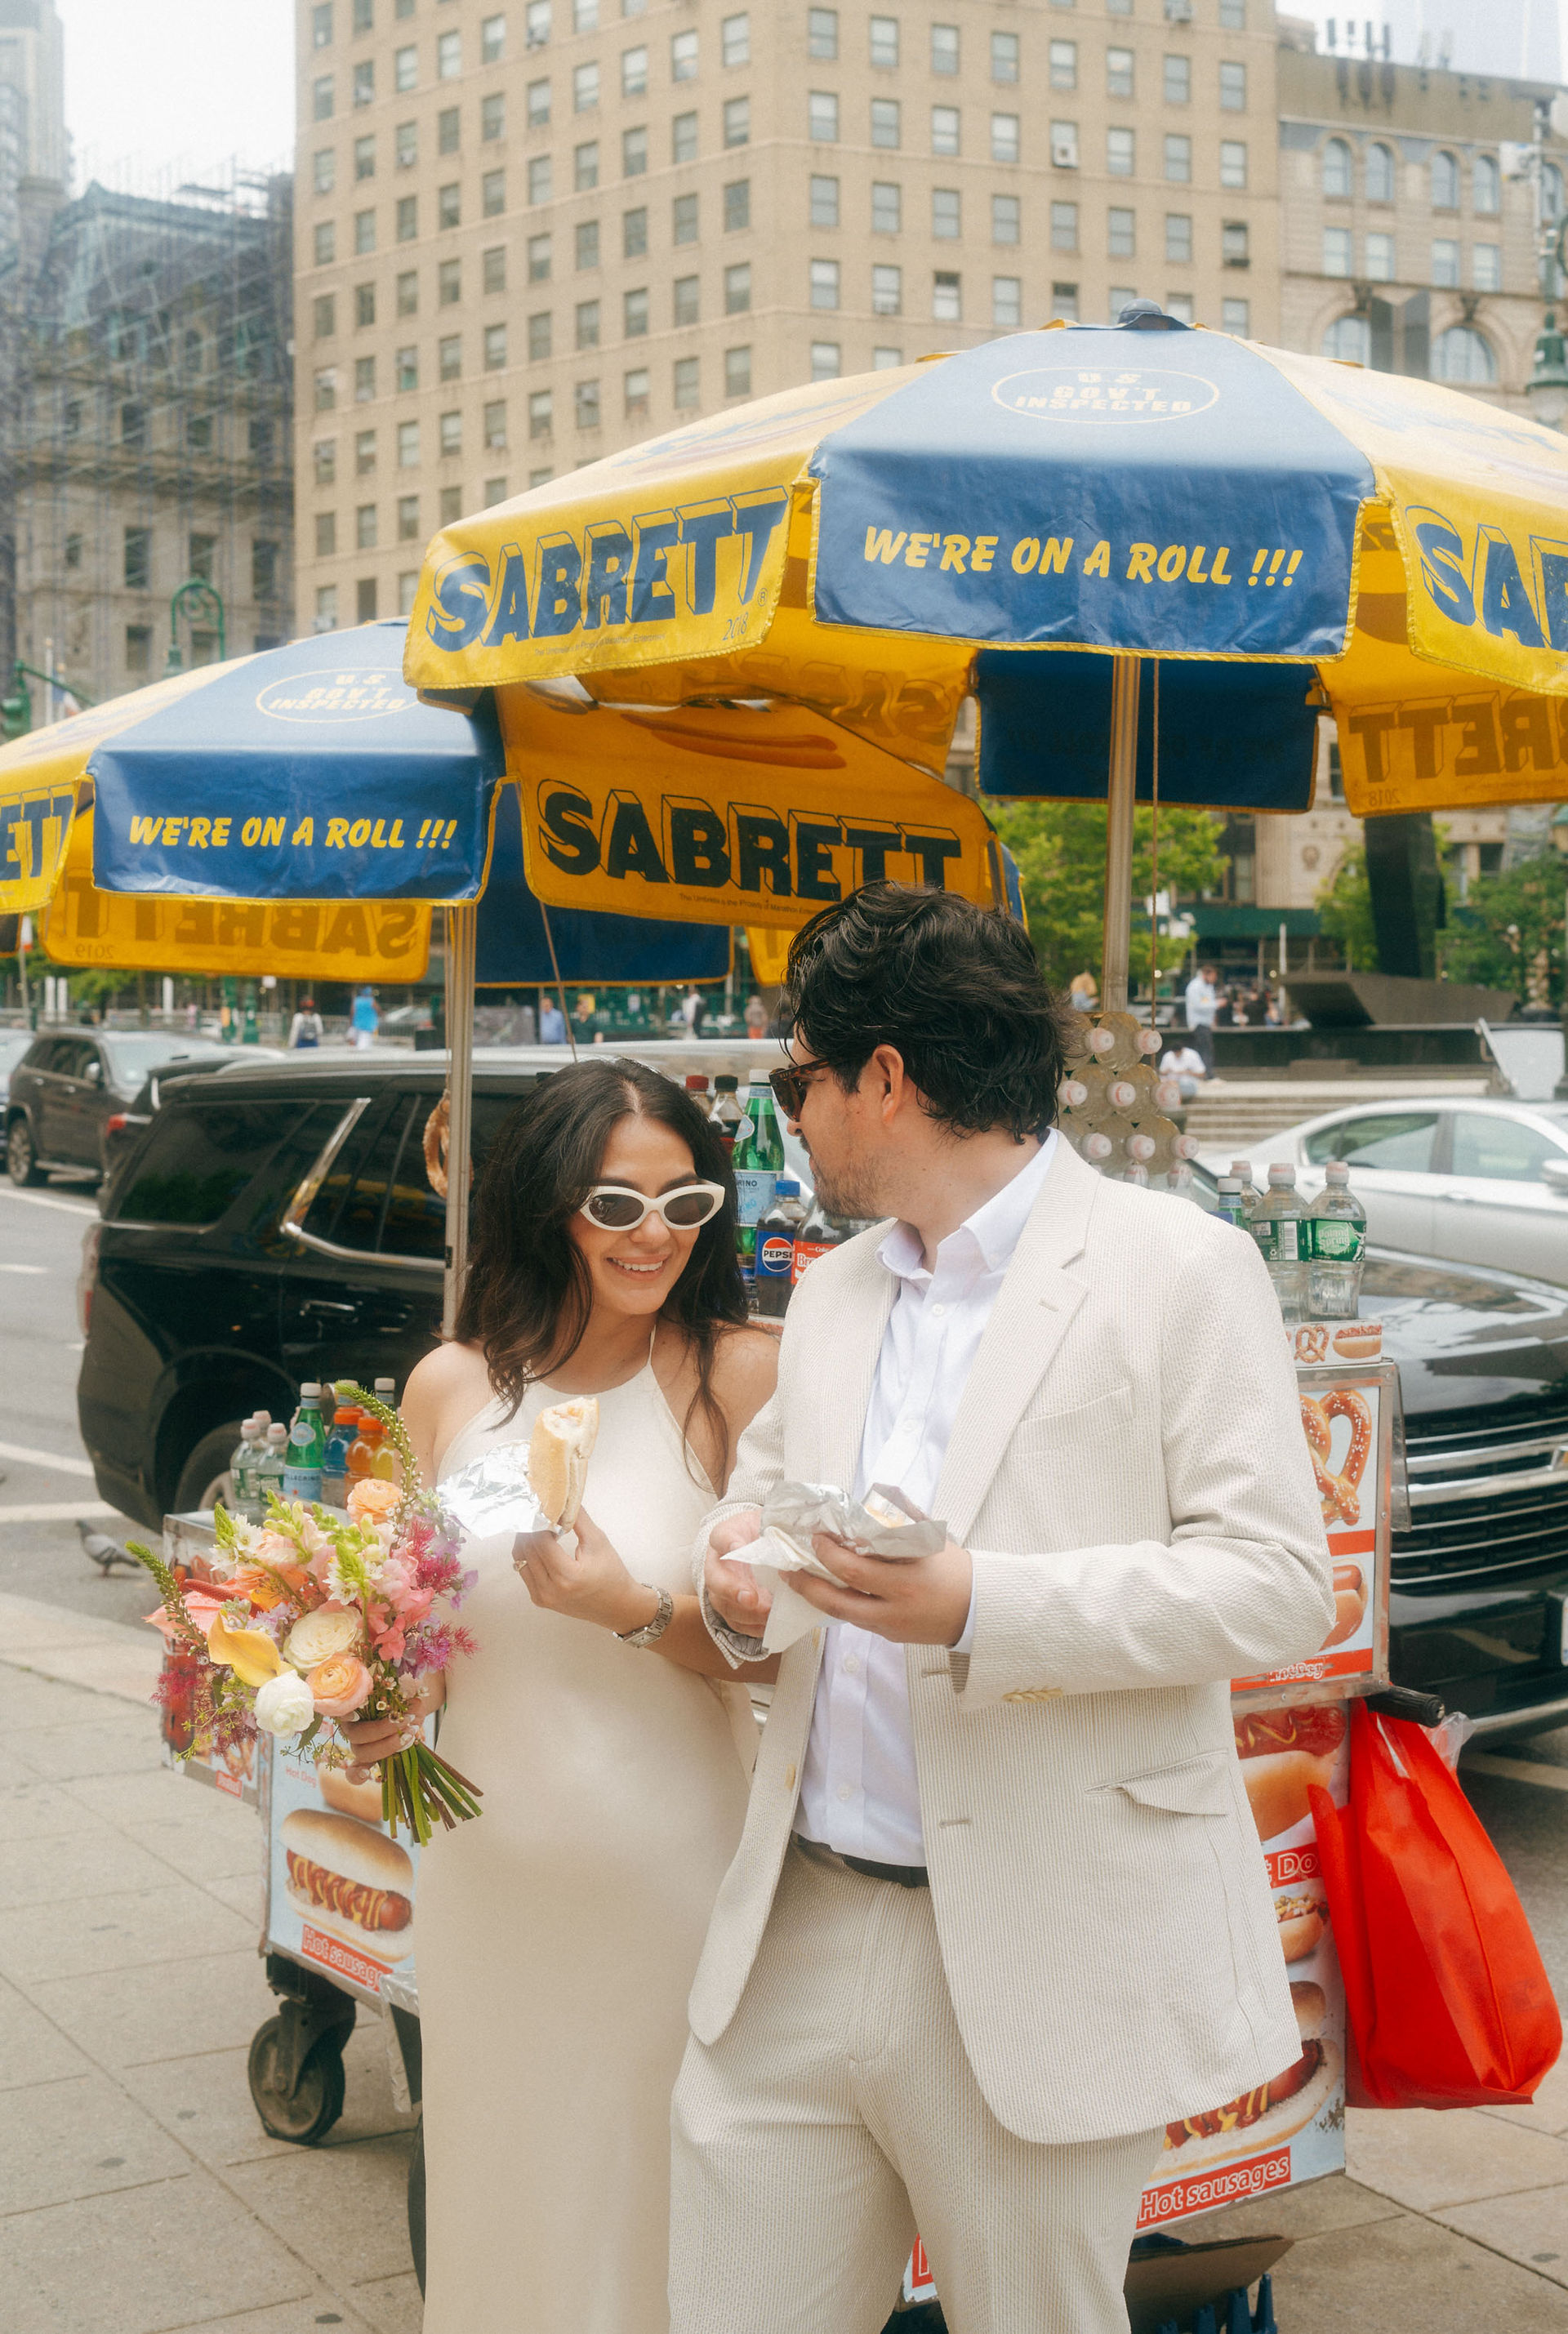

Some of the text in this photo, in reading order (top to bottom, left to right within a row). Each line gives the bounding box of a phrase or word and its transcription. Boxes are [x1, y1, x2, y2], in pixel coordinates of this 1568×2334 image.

[1014, 395, 1192, 412] INSPECTED
[425, 484, 790, 653] SABRETT
[864, 525, 1303, 587] WE'RE ON A ROLL !!!
[722, 612, 750, 641] 2018
[268, 698, 406, 710] INSPECTED
[128, 815, 458, 850] WE'RE ON A ROLL !!!
[537, 777, 962, 902] SABRETT
[1319, 1238, 1350, 1249] Spring
[285, 1764, 316, 1788] Hot Dog
[1277, 1852, 1319, 1880] Do
[302, 1926, 383, 1989] Hot sausag
[1138, 2156, 1289, 2222] Hot sausages
